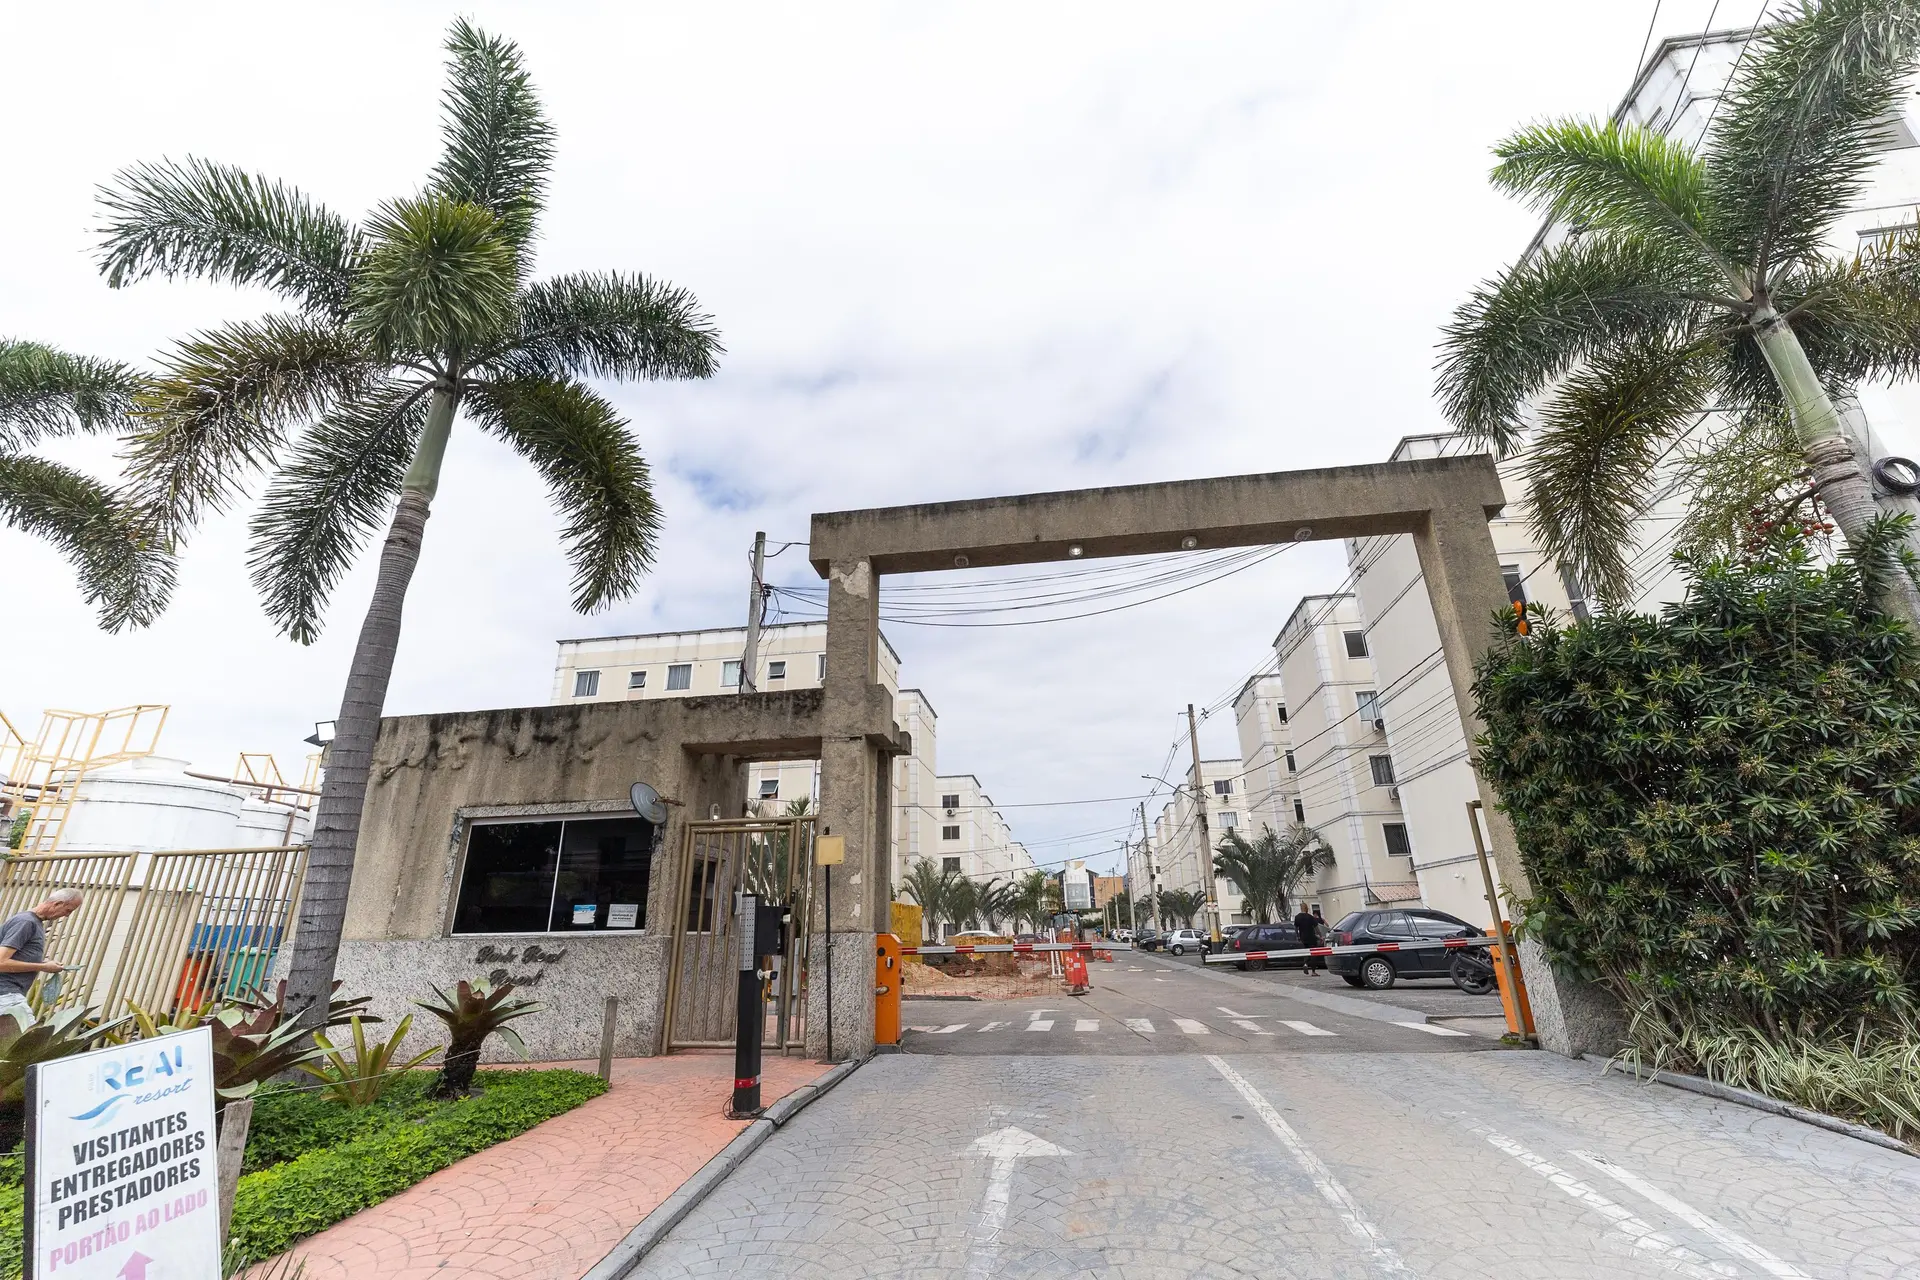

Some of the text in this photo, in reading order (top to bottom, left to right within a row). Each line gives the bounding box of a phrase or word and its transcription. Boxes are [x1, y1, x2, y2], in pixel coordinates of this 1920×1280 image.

[133, 1078, 193, 1105] resort
[51, 1130, 205, 1204] ENTREGADORES
[73, 1111, 188, 1165] VISITANTES
[50, 1188, 208, 1272] PORTÃO AO LADO
[58, 1158, 201, 1231] PRESTADORES
